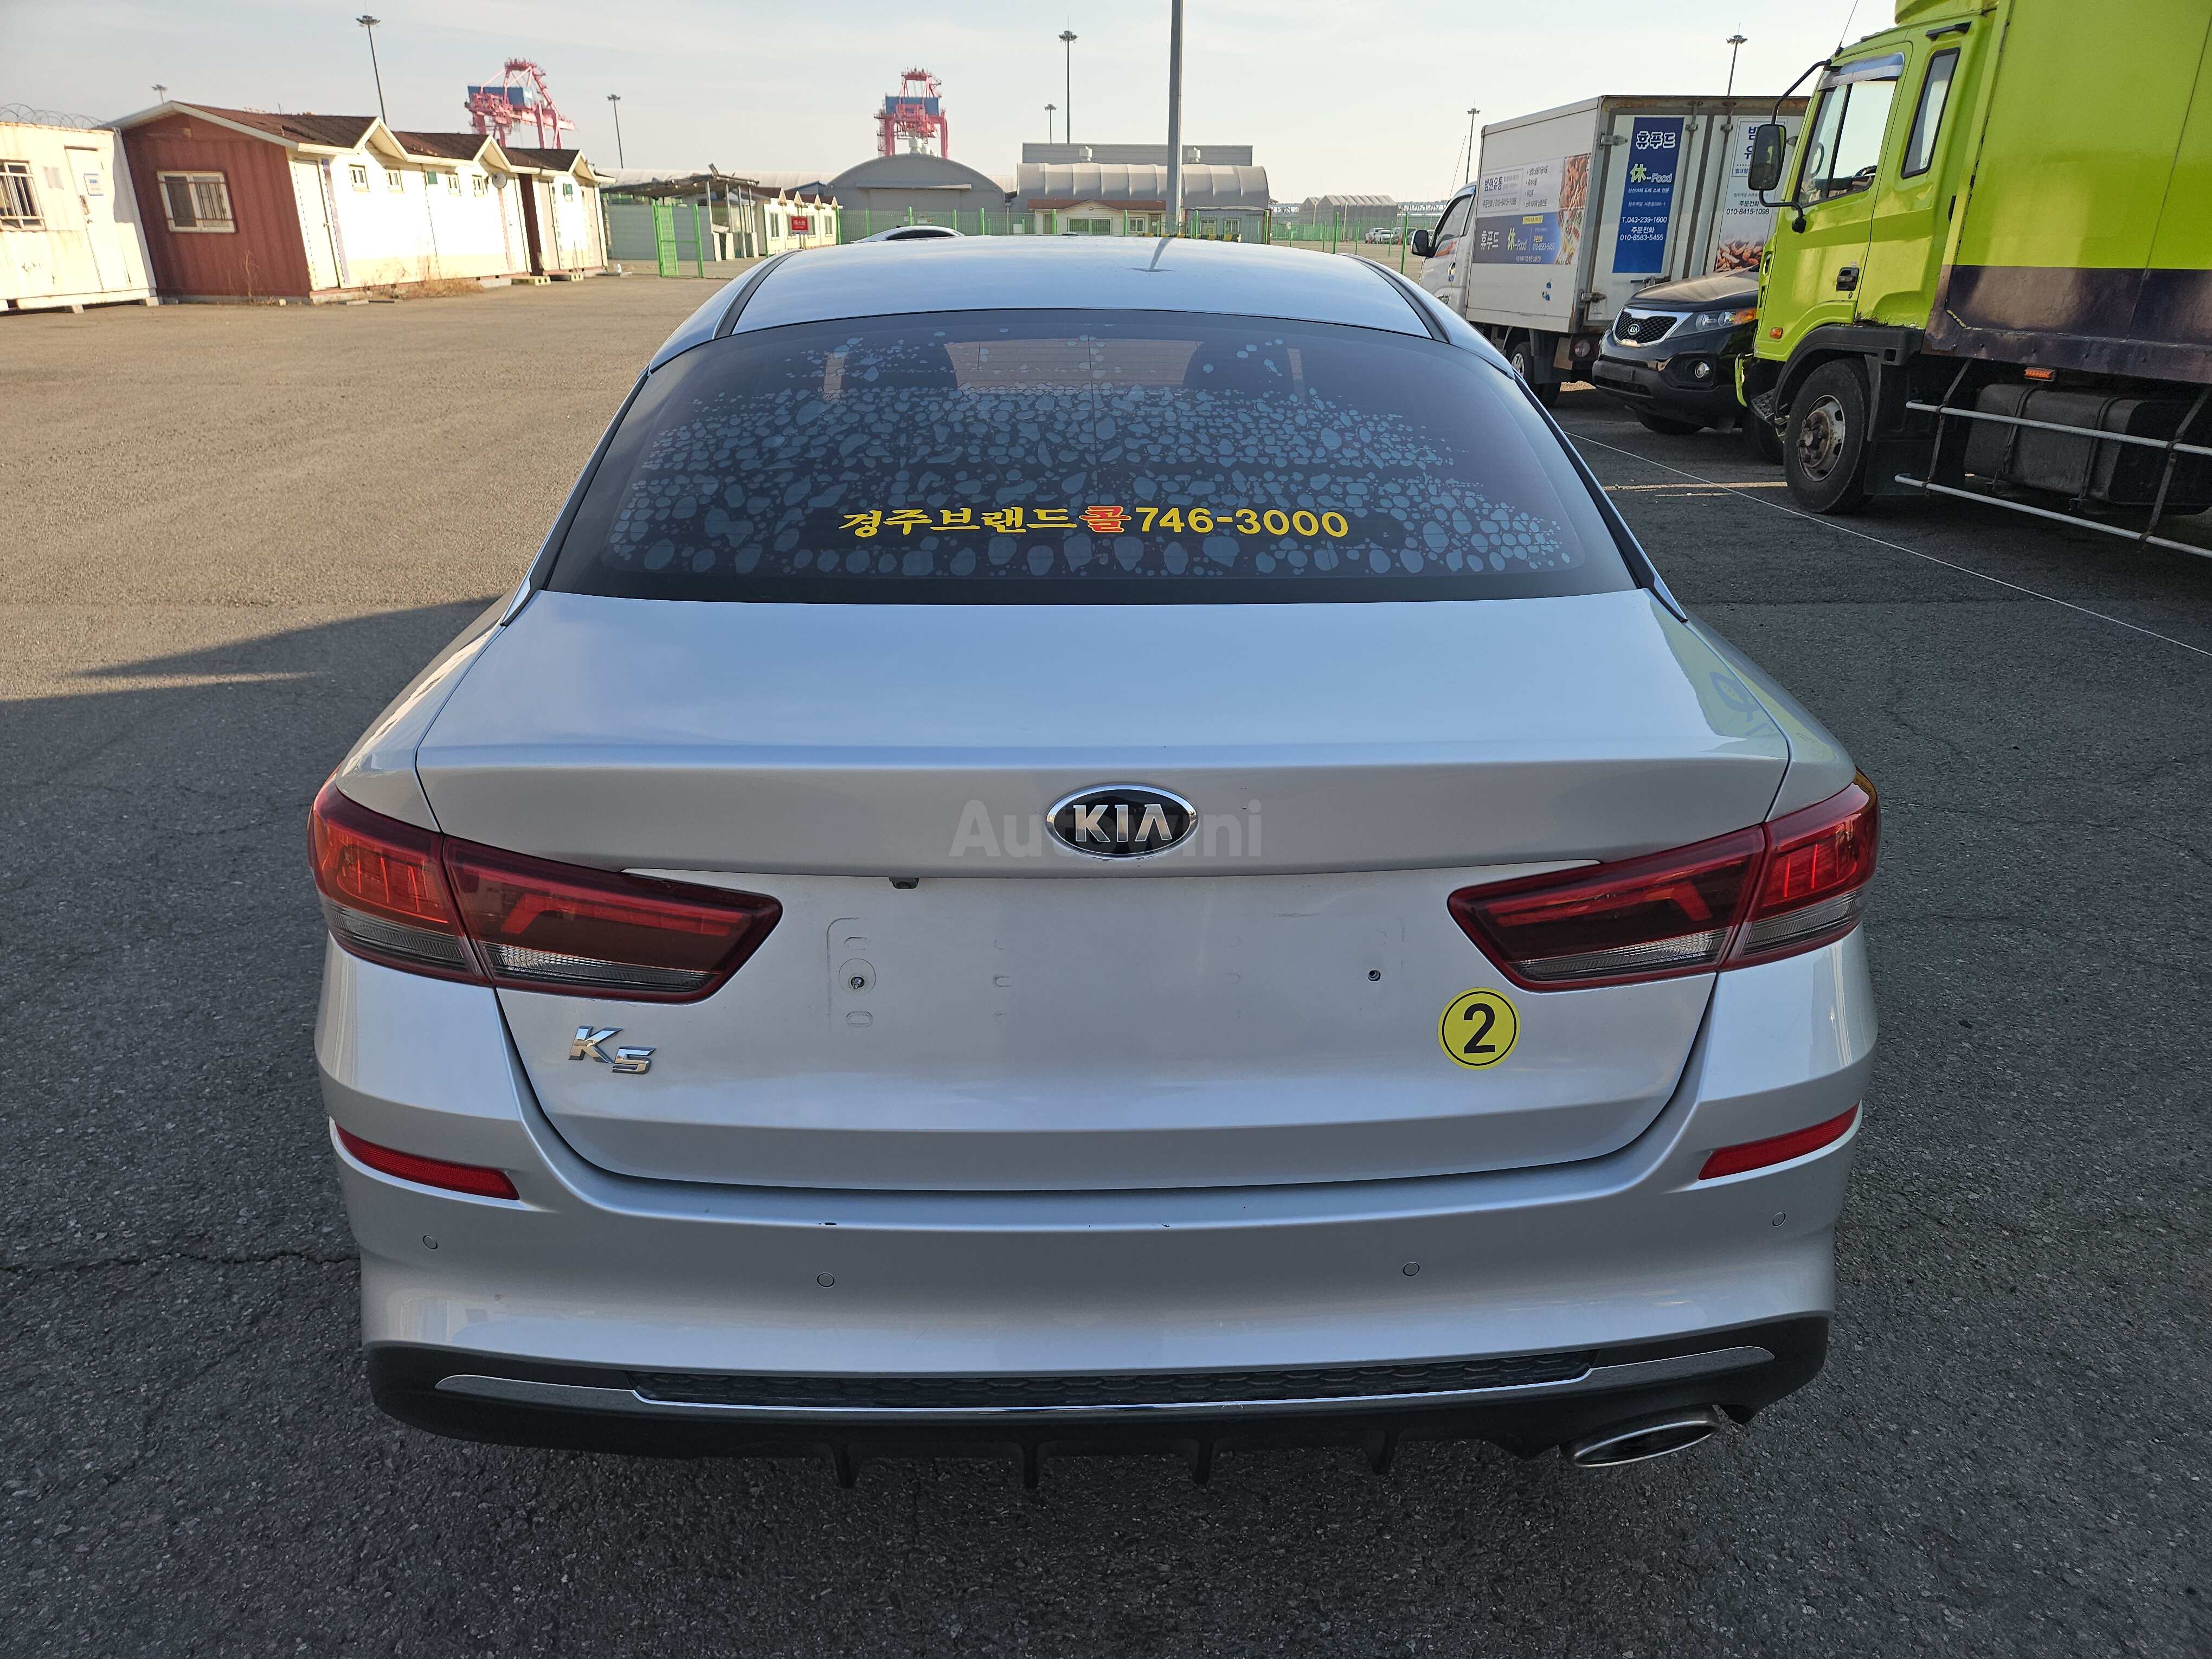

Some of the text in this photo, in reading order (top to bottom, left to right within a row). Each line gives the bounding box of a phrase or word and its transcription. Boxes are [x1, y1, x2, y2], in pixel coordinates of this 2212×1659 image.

[1636, 131, 1676, 150] 휴푸드
[1480, 230, 1499, 250] 휴푸드
[1136, 507, 1348, 537] 746-3000
[1073, 804, 1173, 843] KIA
[1463, 1002, 1496, 1054] 2
[568, 1025, 656, 1075] K5
